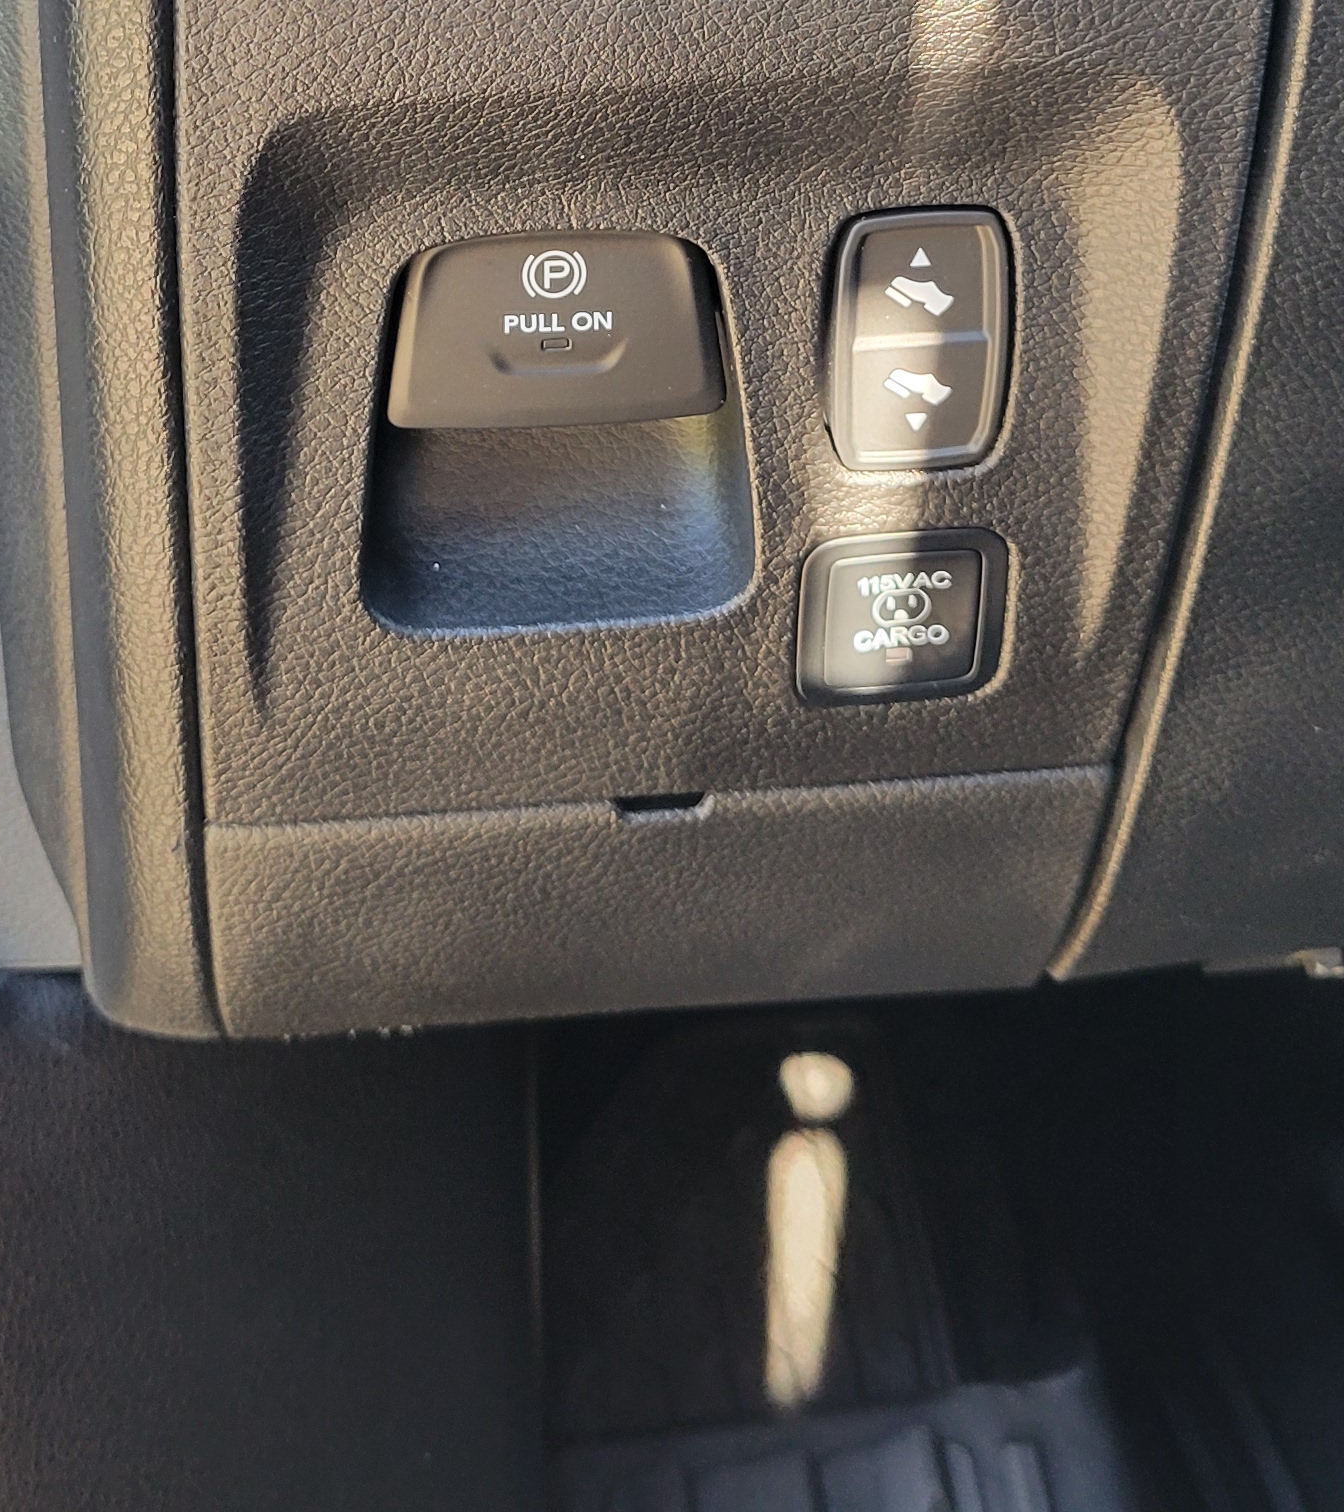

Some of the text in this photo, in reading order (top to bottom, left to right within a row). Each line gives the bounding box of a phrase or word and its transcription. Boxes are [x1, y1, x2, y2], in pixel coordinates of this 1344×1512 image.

[543, 260, 570, 289] P
[503, 310, 613, 334] PULL ON
[857, 570, 952, 596] 115VAC
[853, 624, 949, 652] CARGO
